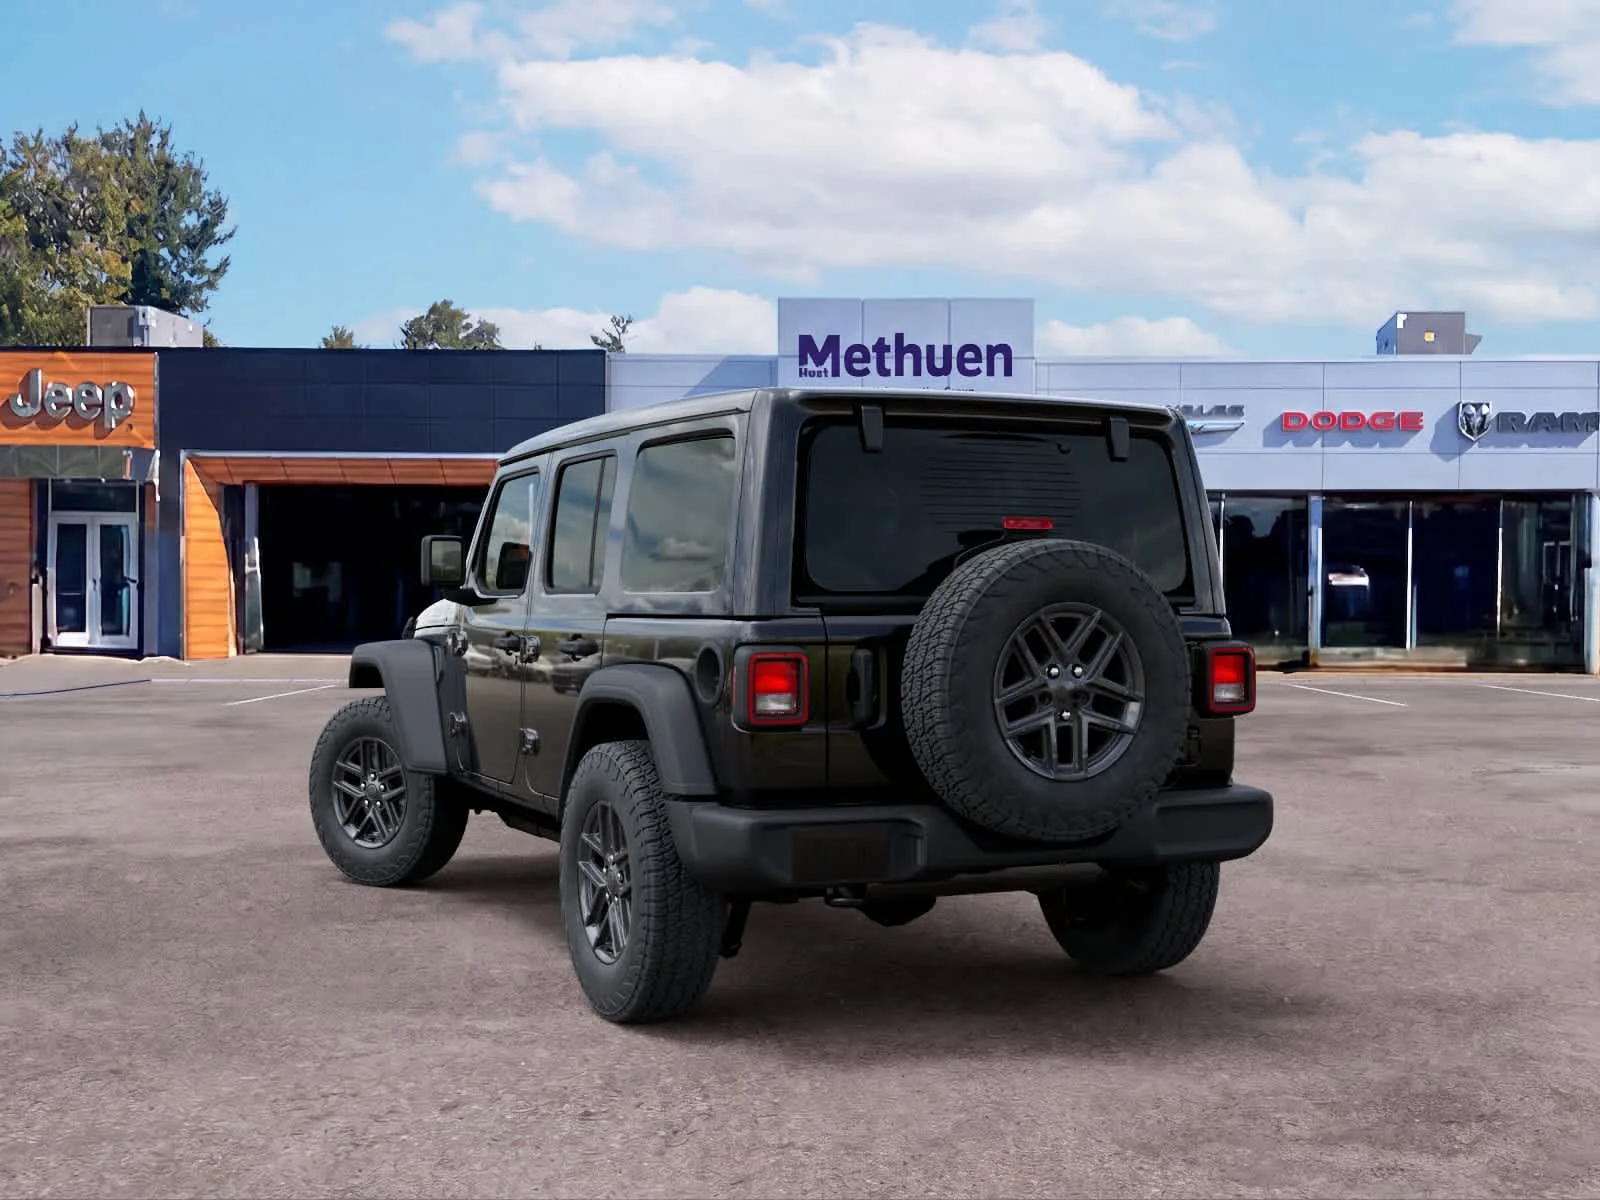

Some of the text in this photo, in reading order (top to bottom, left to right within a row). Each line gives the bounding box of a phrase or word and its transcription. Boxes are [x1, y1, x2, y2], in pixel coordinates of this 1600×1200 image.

[799, 333, 1013, 378] Methuen
[9, 368, 136, 429] Jeep
[1282, 411, 1423, 431] DODGE
[1497, 411, 1600, 433] RAM
